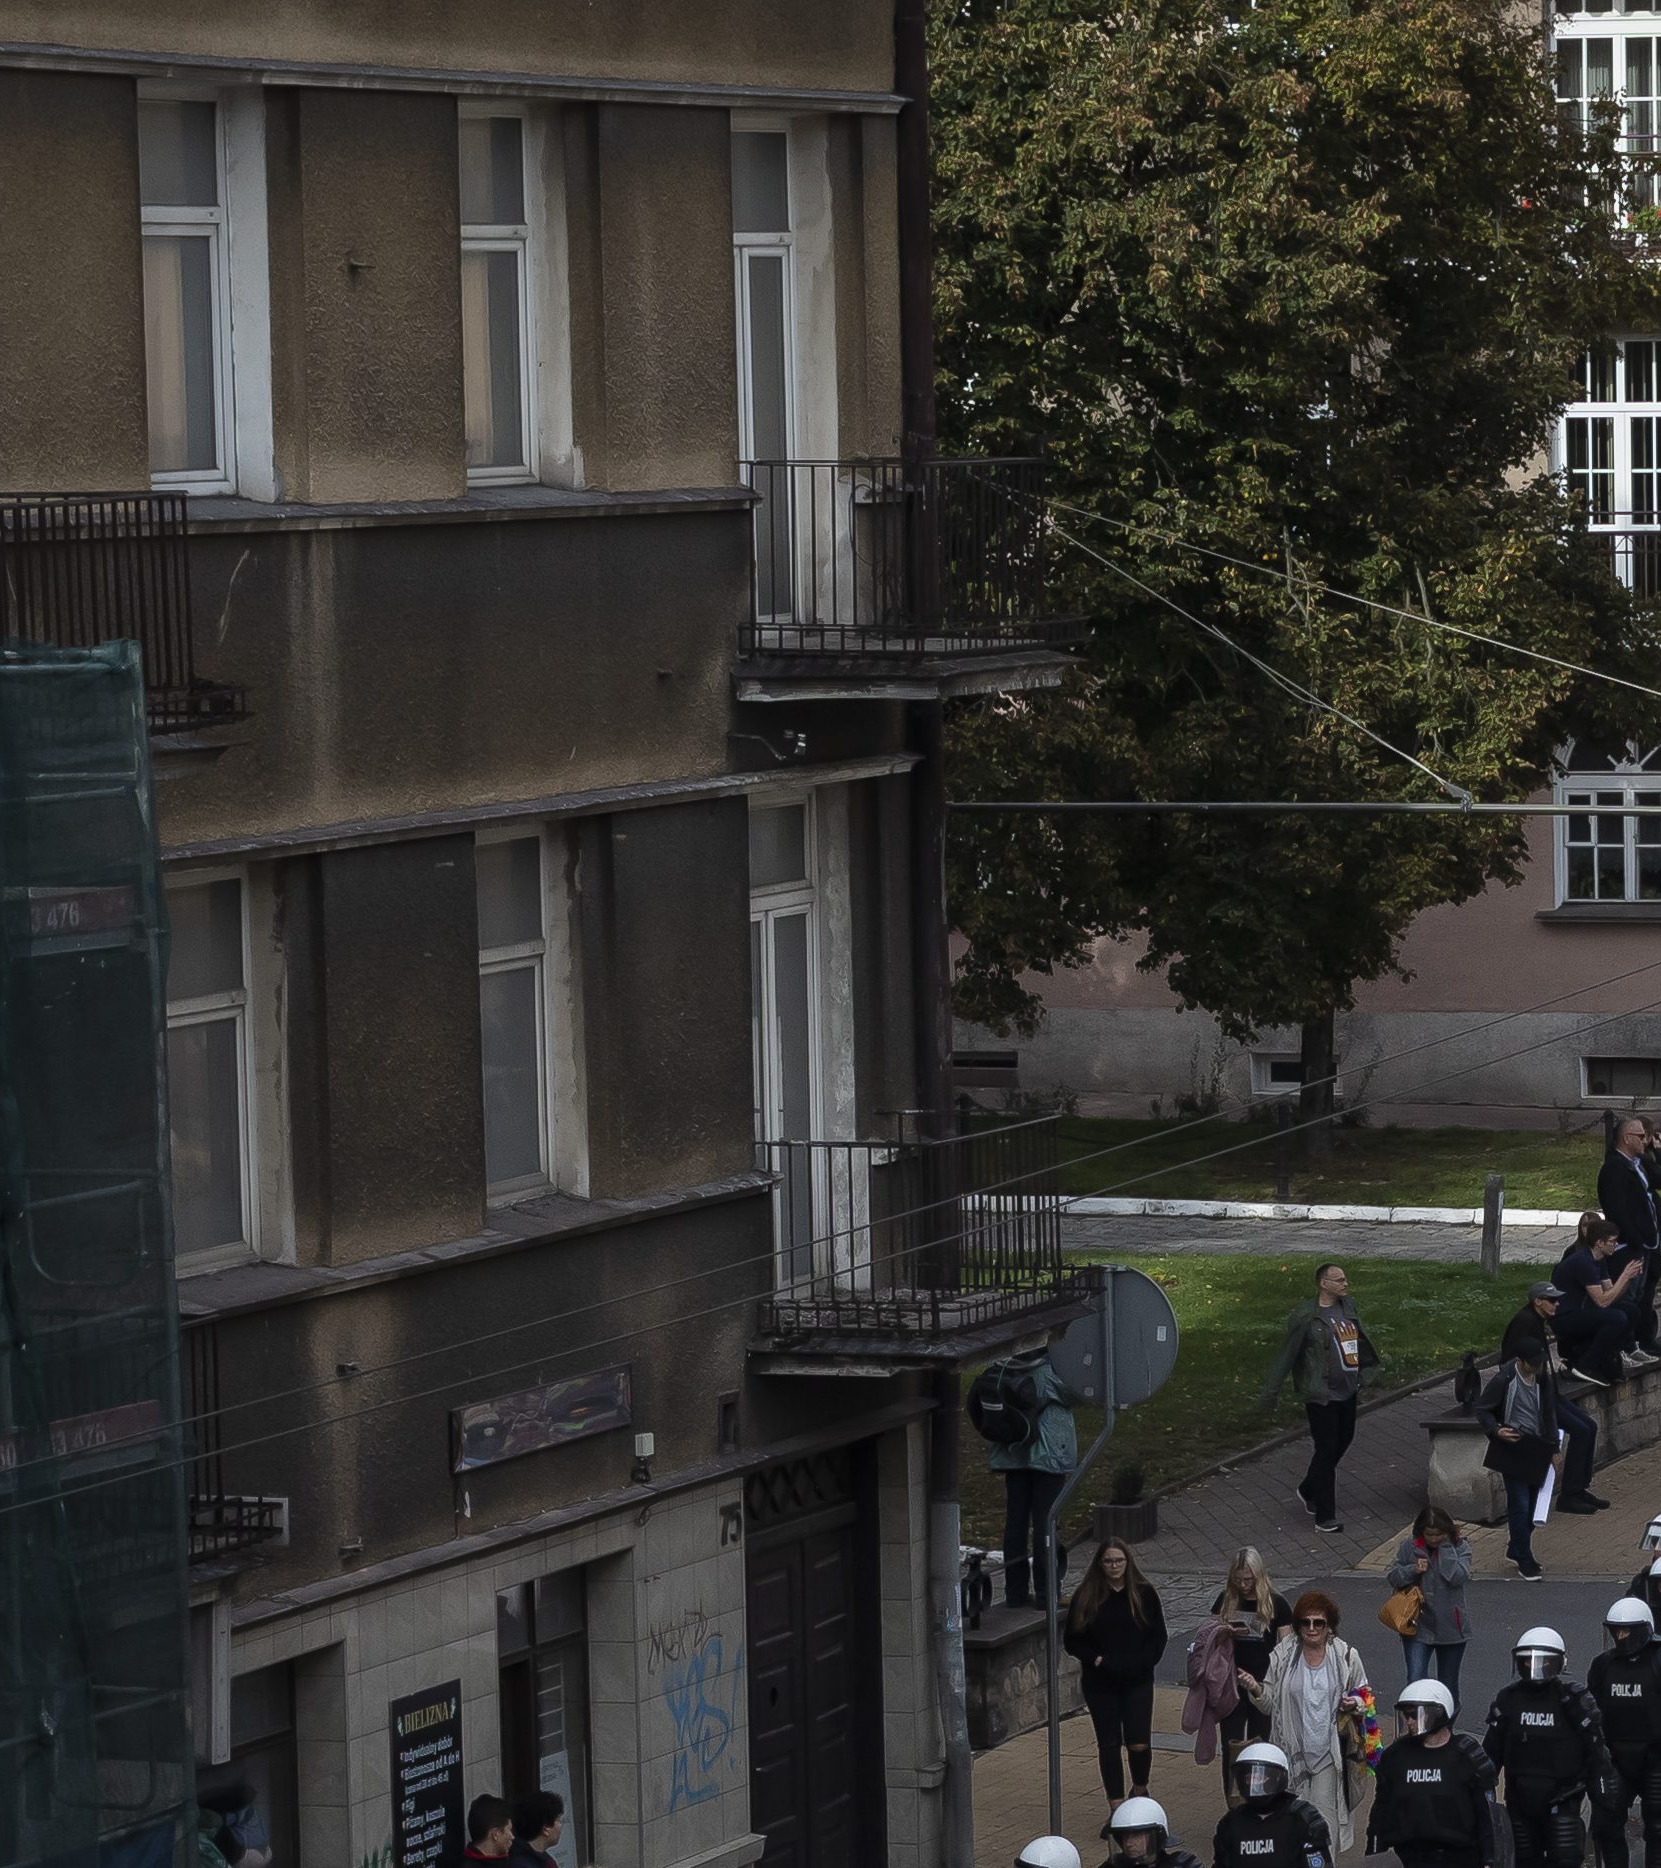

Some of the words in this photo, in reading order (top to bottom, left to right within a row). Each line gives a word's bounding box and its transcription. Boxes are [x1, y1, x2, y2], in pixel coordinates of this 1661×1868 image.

[404, 1701, 449, 1734] BIELIZNA
[1520, 1711, 1555, 1727] POLICJA
[1406, 1768, 1442, 1784] POLICJA
[1240, 1839, 1275, 1856] POLICJA
